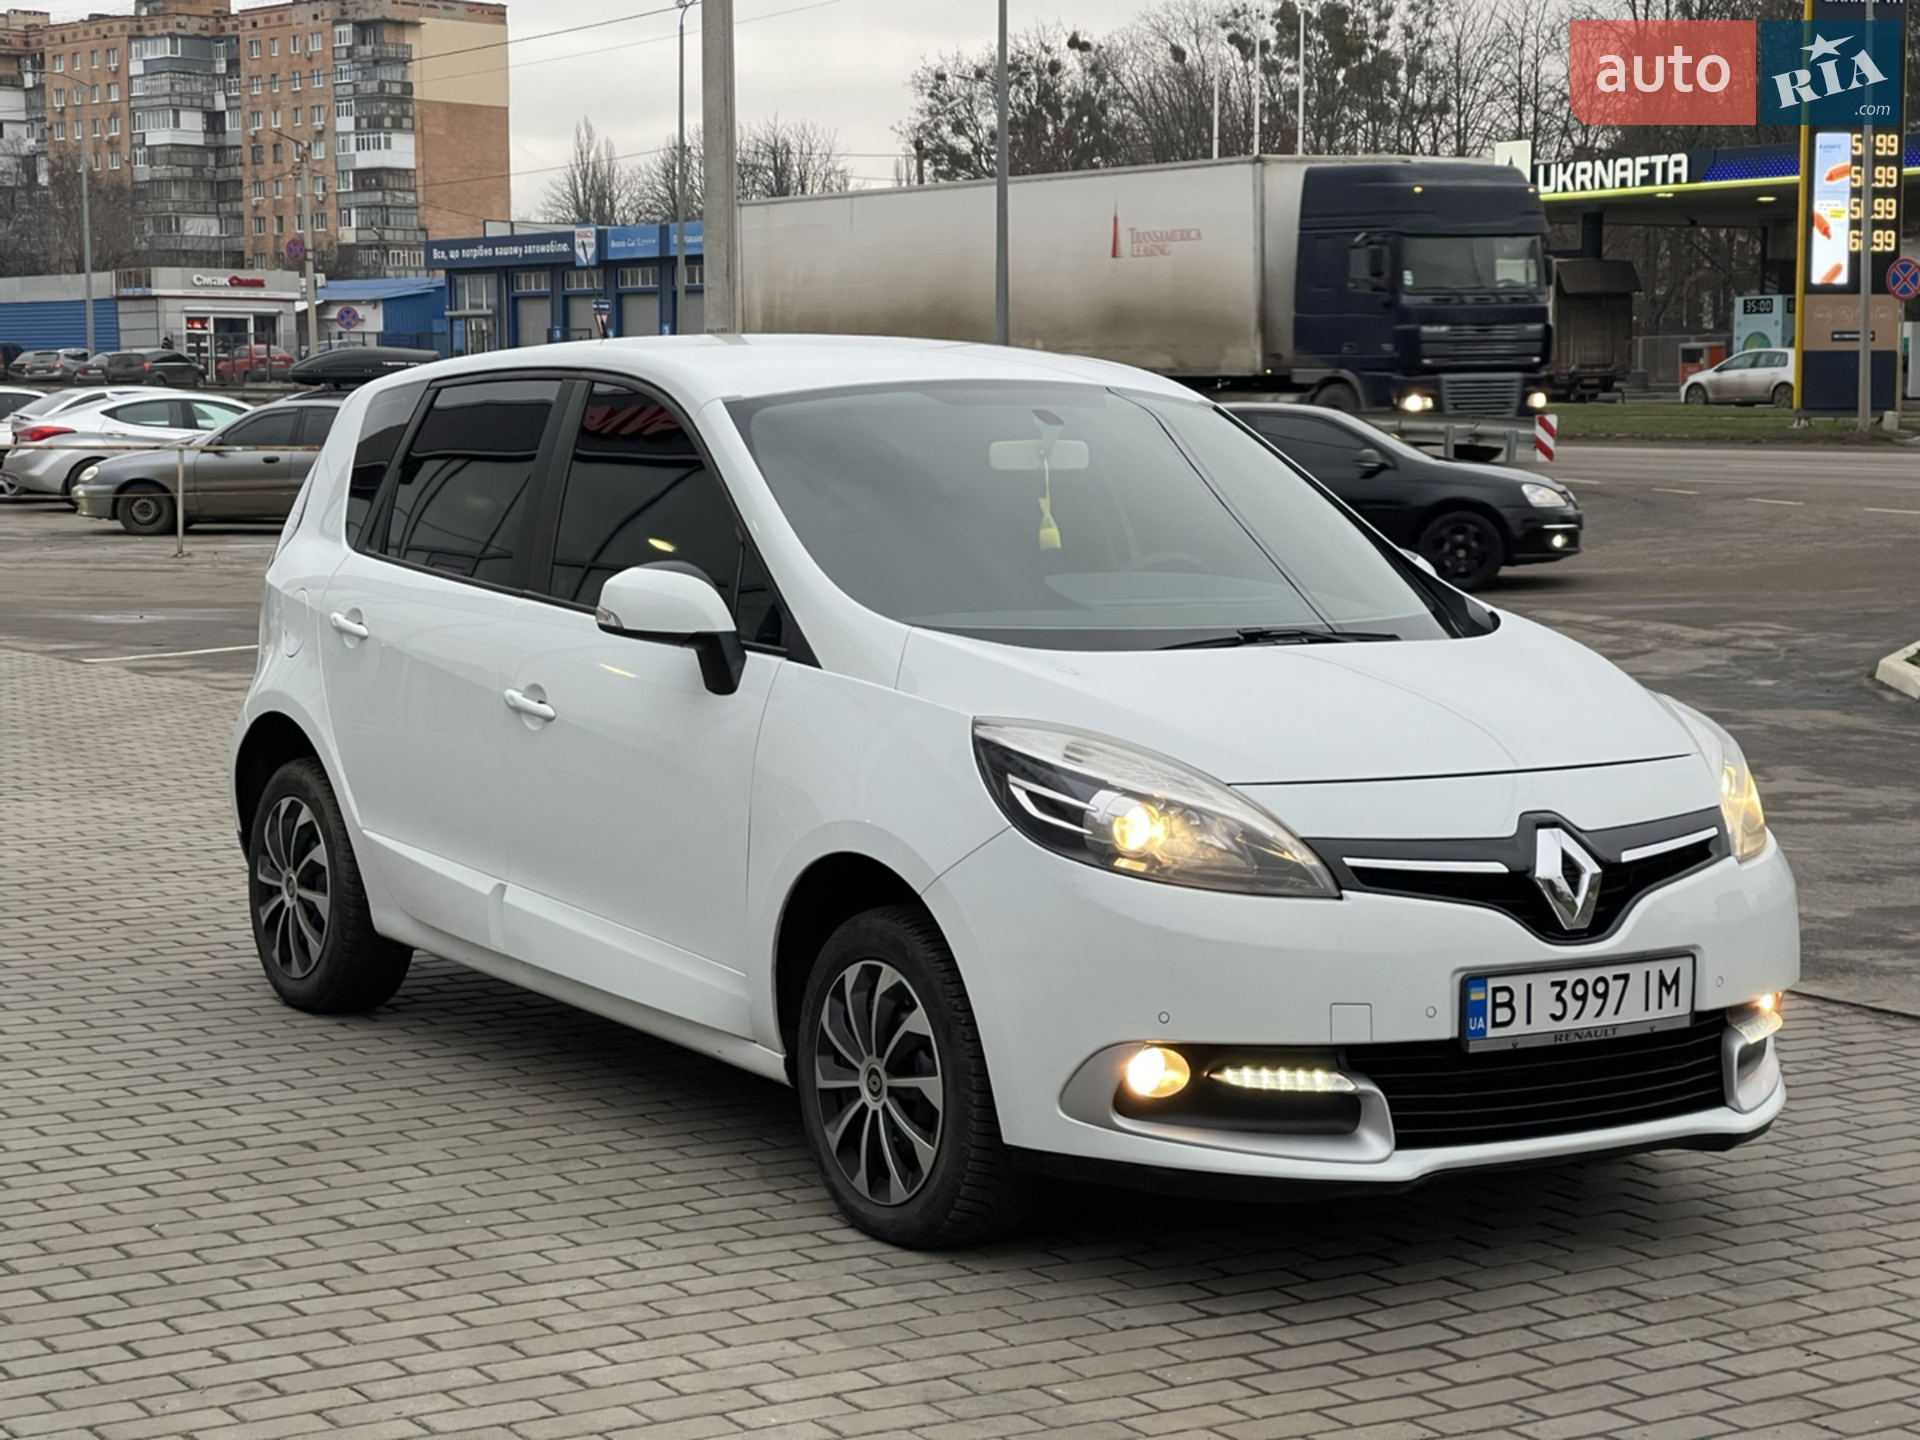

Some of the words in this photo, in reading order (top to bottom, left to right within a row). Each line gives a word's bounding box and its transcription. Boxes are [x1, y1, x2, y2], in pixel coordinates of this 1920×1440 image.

[1539, 153, 1688, 193] UKRNAFTA
[433, 248, 448, 261] Все,
[450, 250, 461, 261] що
[462, 245, 493, 260] потрібно
[495, 246, 523, 258] вашому
[524, 240, 571, 255] автомобілю.
[1491, 983, 1532, 1029] BI
[1549, 973, 1630, 1022] 3997
[1645, 967, 1680, 1012] IM
[1469, 1017, 1485, 1031] UA
[1554, 1028, 1619, 1043] RENAULT
